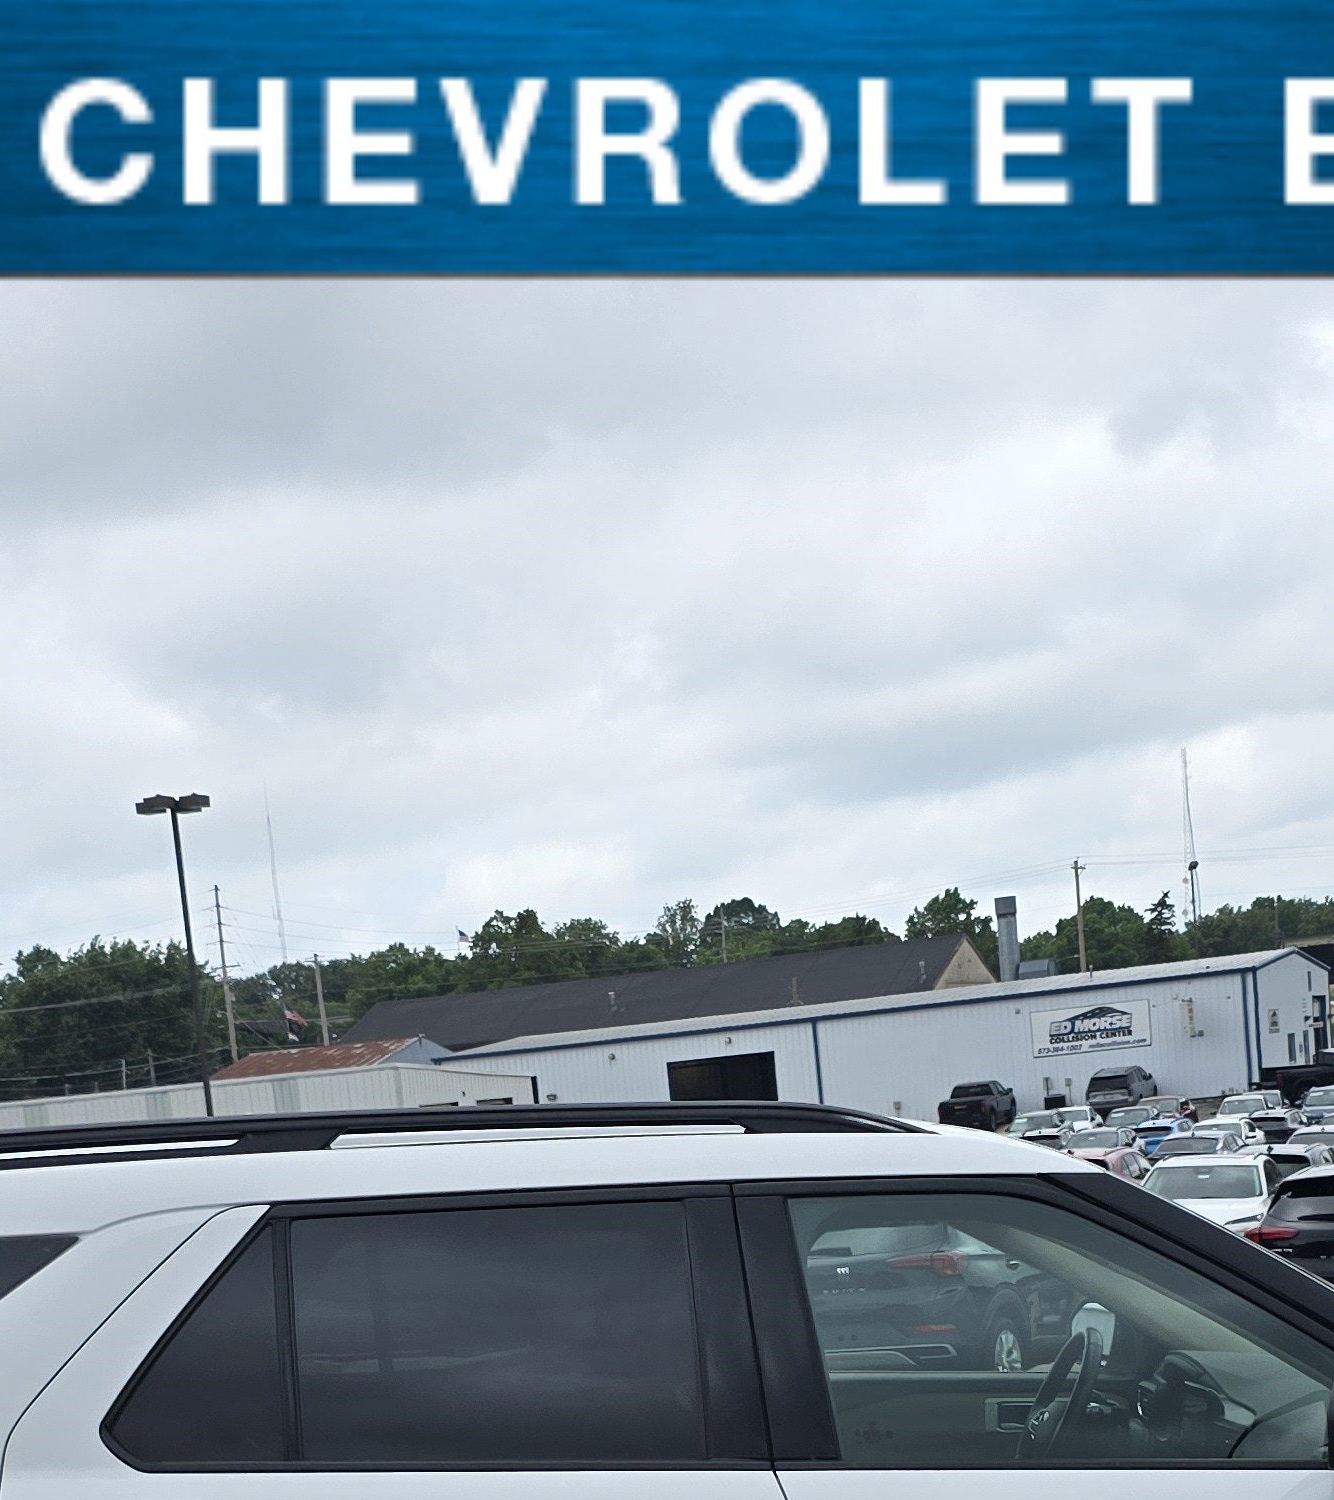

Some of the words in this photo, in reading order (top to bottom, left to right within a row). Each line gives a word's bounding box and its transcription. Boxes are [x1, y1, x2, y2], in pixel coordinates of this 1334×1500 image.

[1050, 1022, 1072, 1034] ED
[1074, 1015, 1132, 1032] MORSE
[1049, 1034, 1097, 1044] COLLISION
[1100, 1029, 1133, 1039] CENTER
